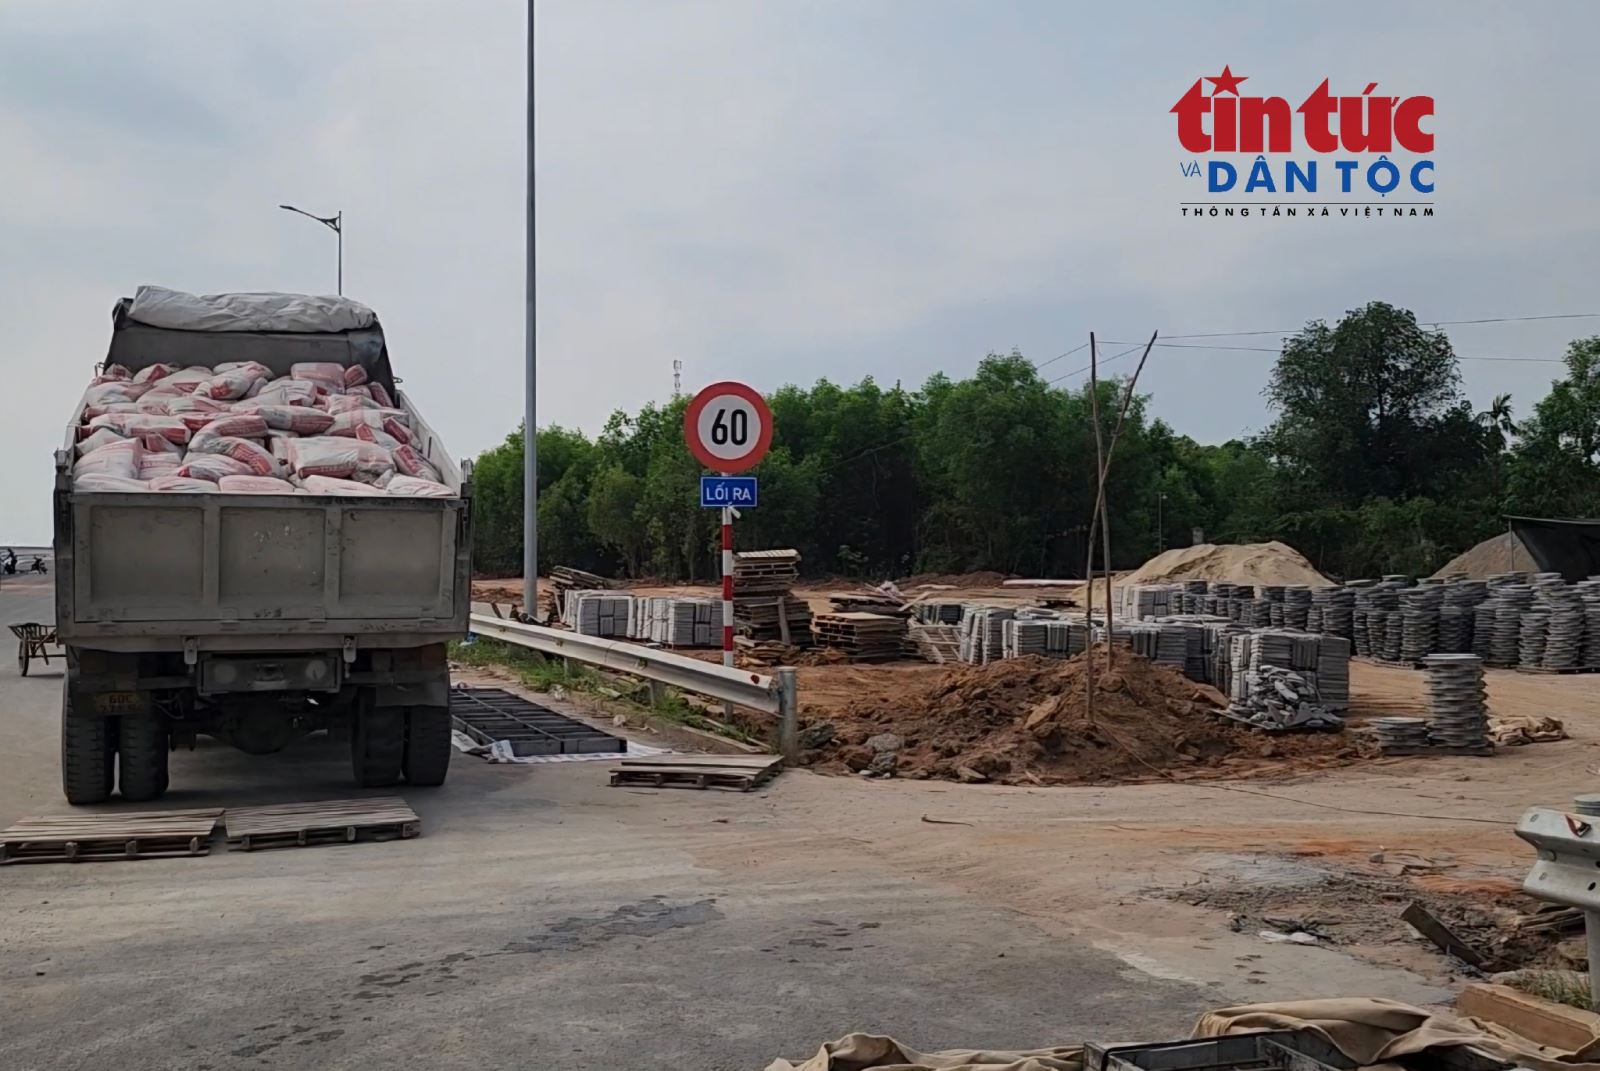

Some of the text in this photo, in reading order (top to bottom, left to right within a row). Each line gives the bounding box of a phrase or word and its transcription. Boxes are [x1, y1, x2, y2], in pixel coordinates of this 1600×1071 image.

[711, 409, 748, 446] 60
[706, 482, 752, 501] LỐI RA
